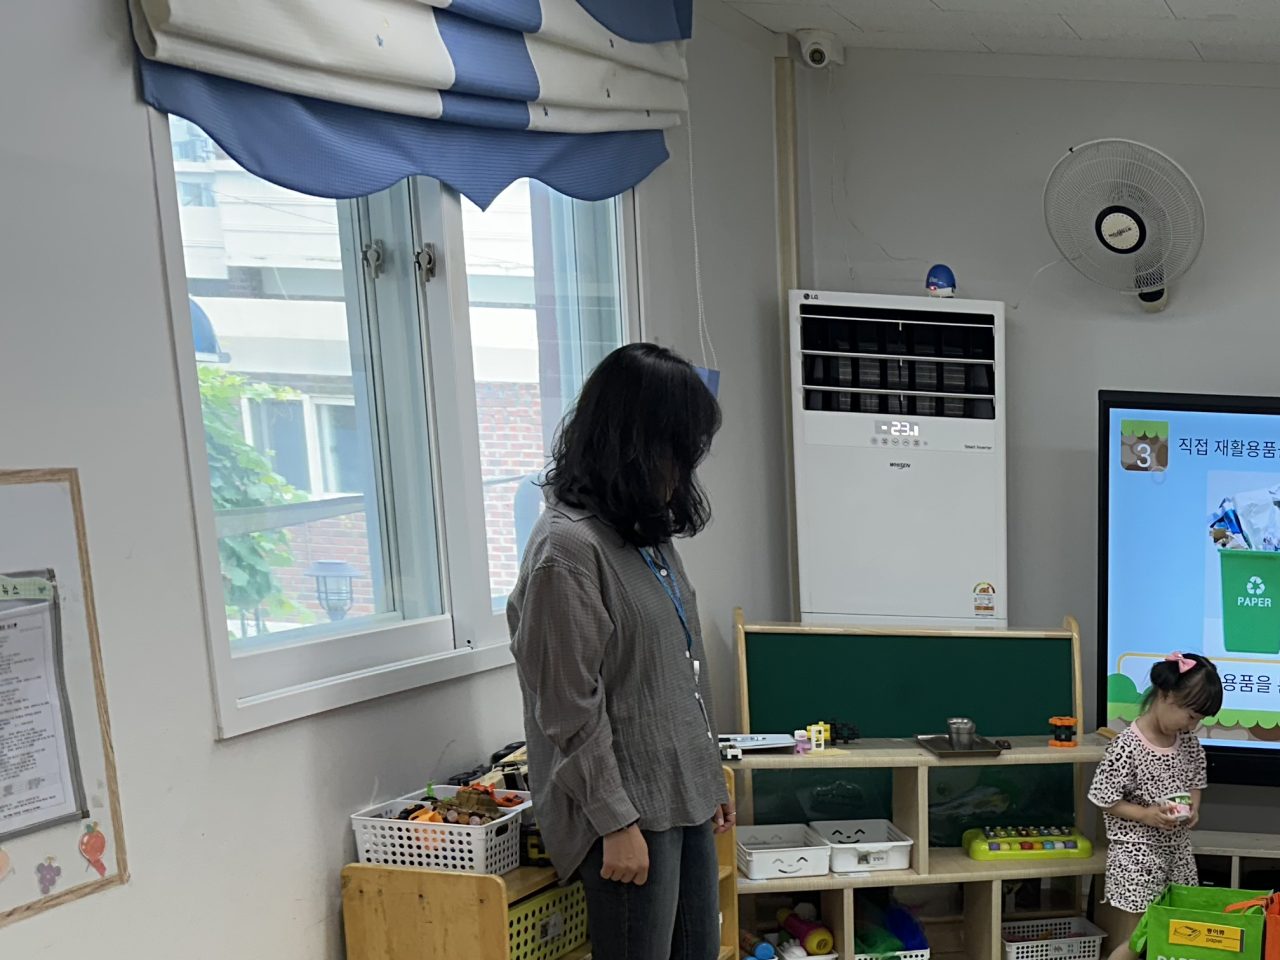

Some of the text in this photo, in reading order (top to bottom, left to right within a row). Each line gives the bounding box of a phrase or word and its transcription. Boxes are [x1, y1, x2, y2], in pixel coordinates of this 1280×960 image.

[1137, 443, 1151, 467] 3
[1178, 437, 1208, 456] 직접
[1237, 596, 1272, 608] PAPER
[1221, 673, 1272, 694] 용품을
